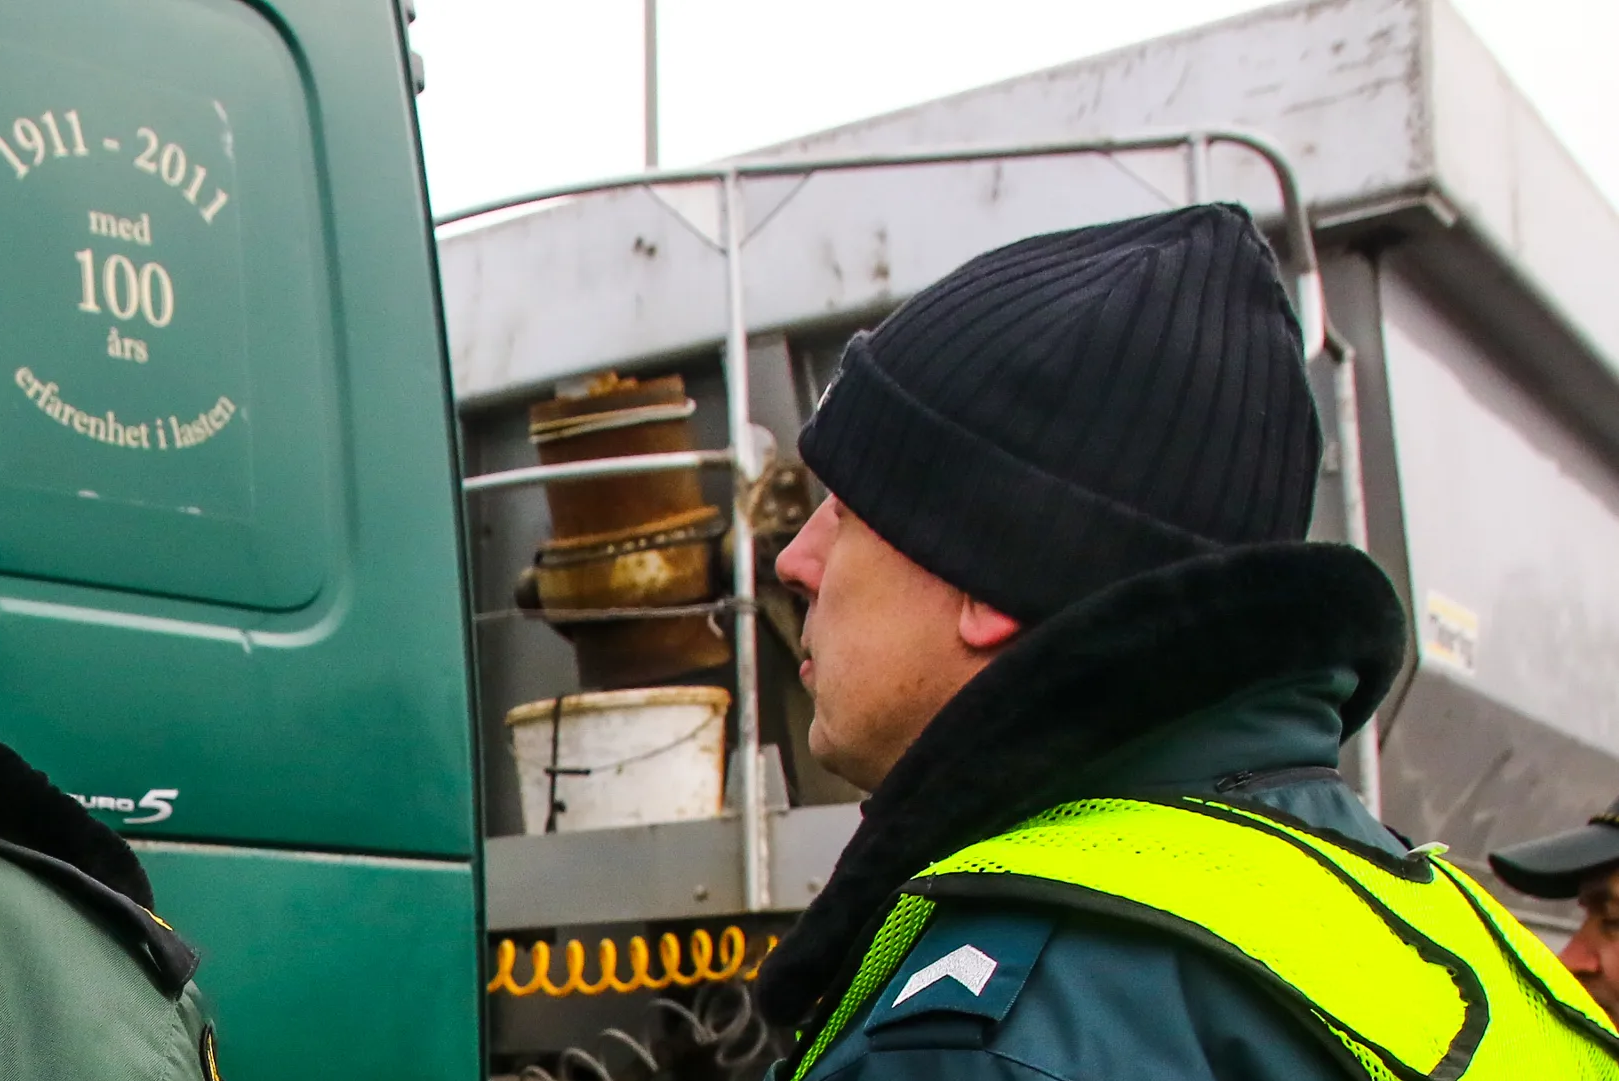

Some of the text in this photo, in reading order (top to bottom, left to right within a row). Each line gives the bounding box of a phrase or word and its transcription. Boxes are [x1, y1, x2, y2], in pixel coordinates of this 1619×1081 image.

[133, 127, 229, 224] 2011
[89, 210, 151, 245] med
[75, 248, 174, 328] 100
[107, 327, 148, 363] års
[15, 366, 236, 449] erfarenhet i lasten
[66, 788, 179, 824] URO 5
